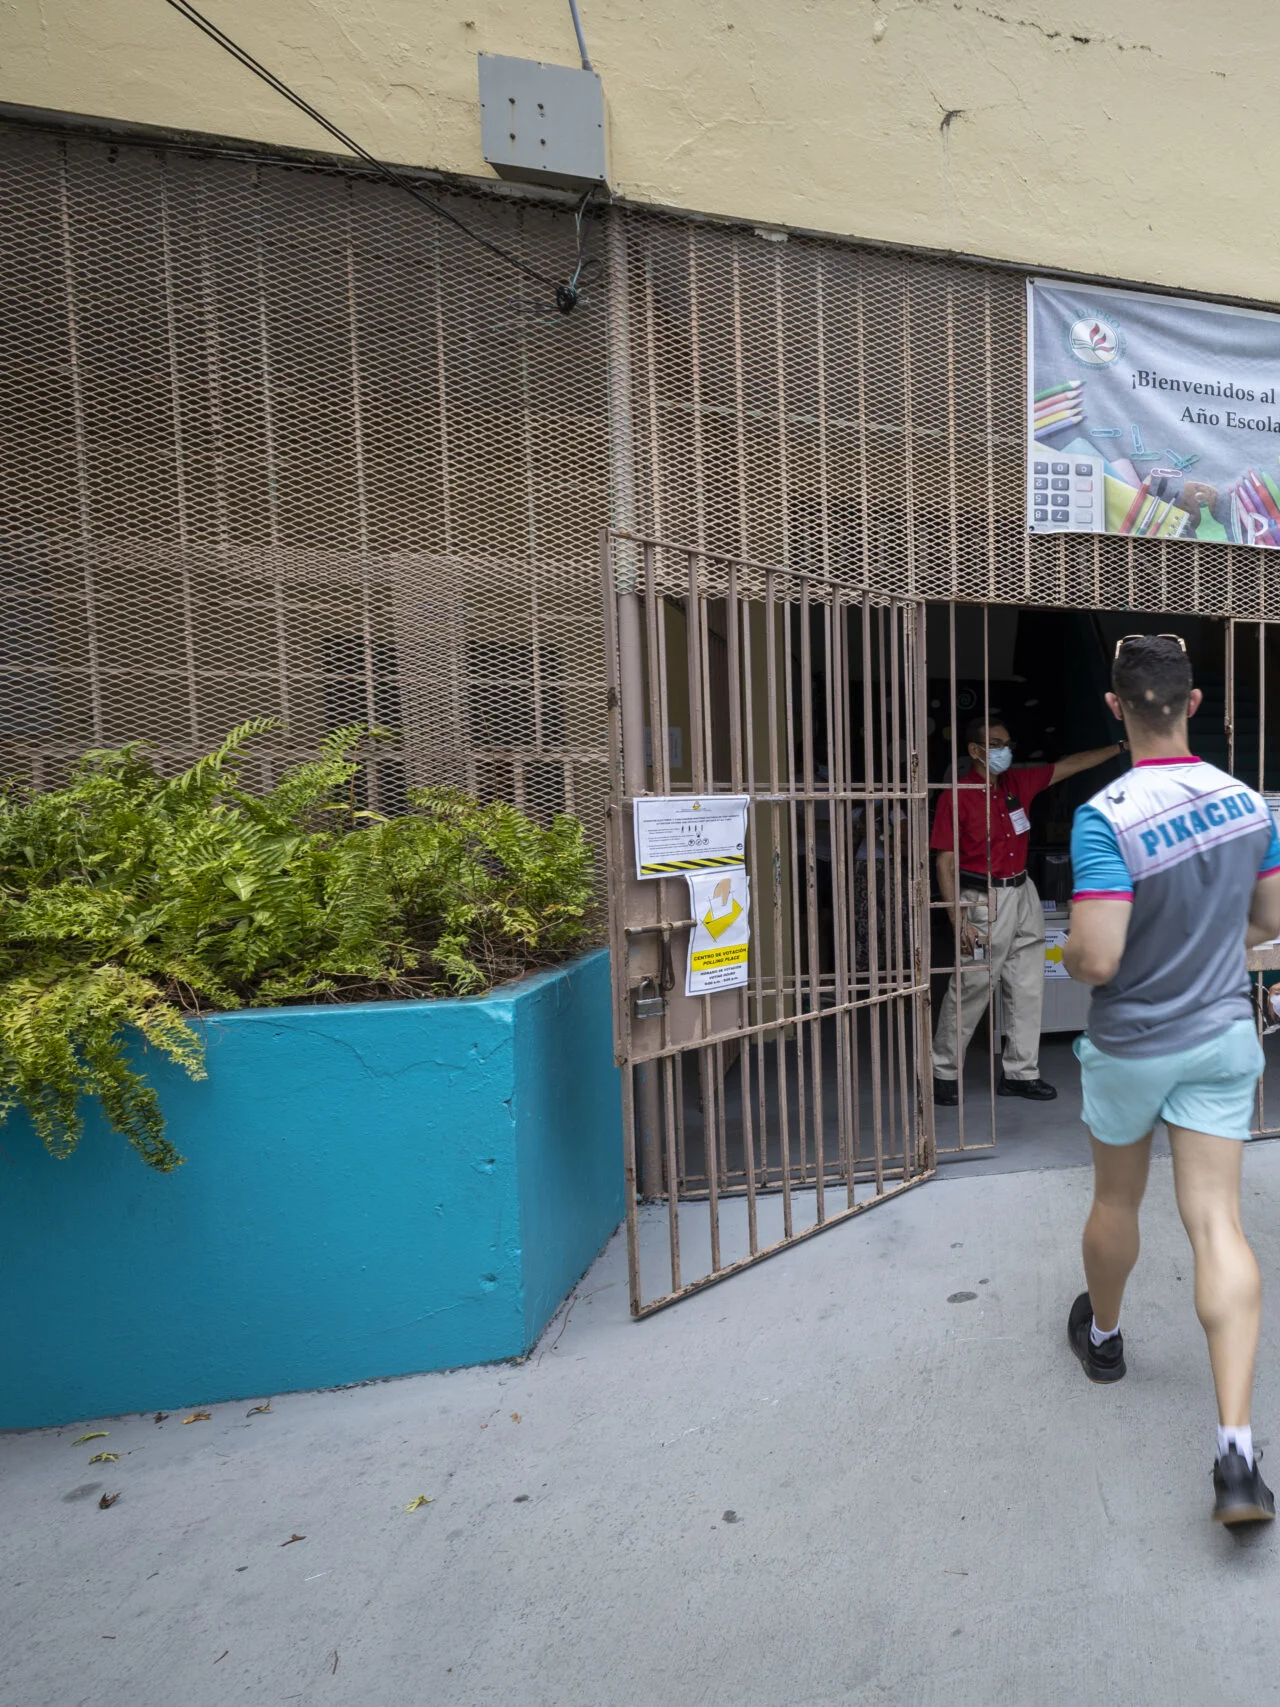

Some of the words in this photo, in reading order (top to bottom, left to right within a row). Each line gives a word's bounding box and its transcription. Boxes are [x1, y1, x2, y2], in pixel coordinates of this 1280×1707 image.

[1131, 369, 1255, 402] ¡Bienvenidos
[1260, 388, 1276, 405] al
[1179, 406, 1220, 426] Año
[1139, 792, 1256, 857] PIKACHU
[694, 953, 715, 961] CENTRO
[722, 948, 747, 956] VOTACIÓN
[702, 958, 724, 966] POLLING
